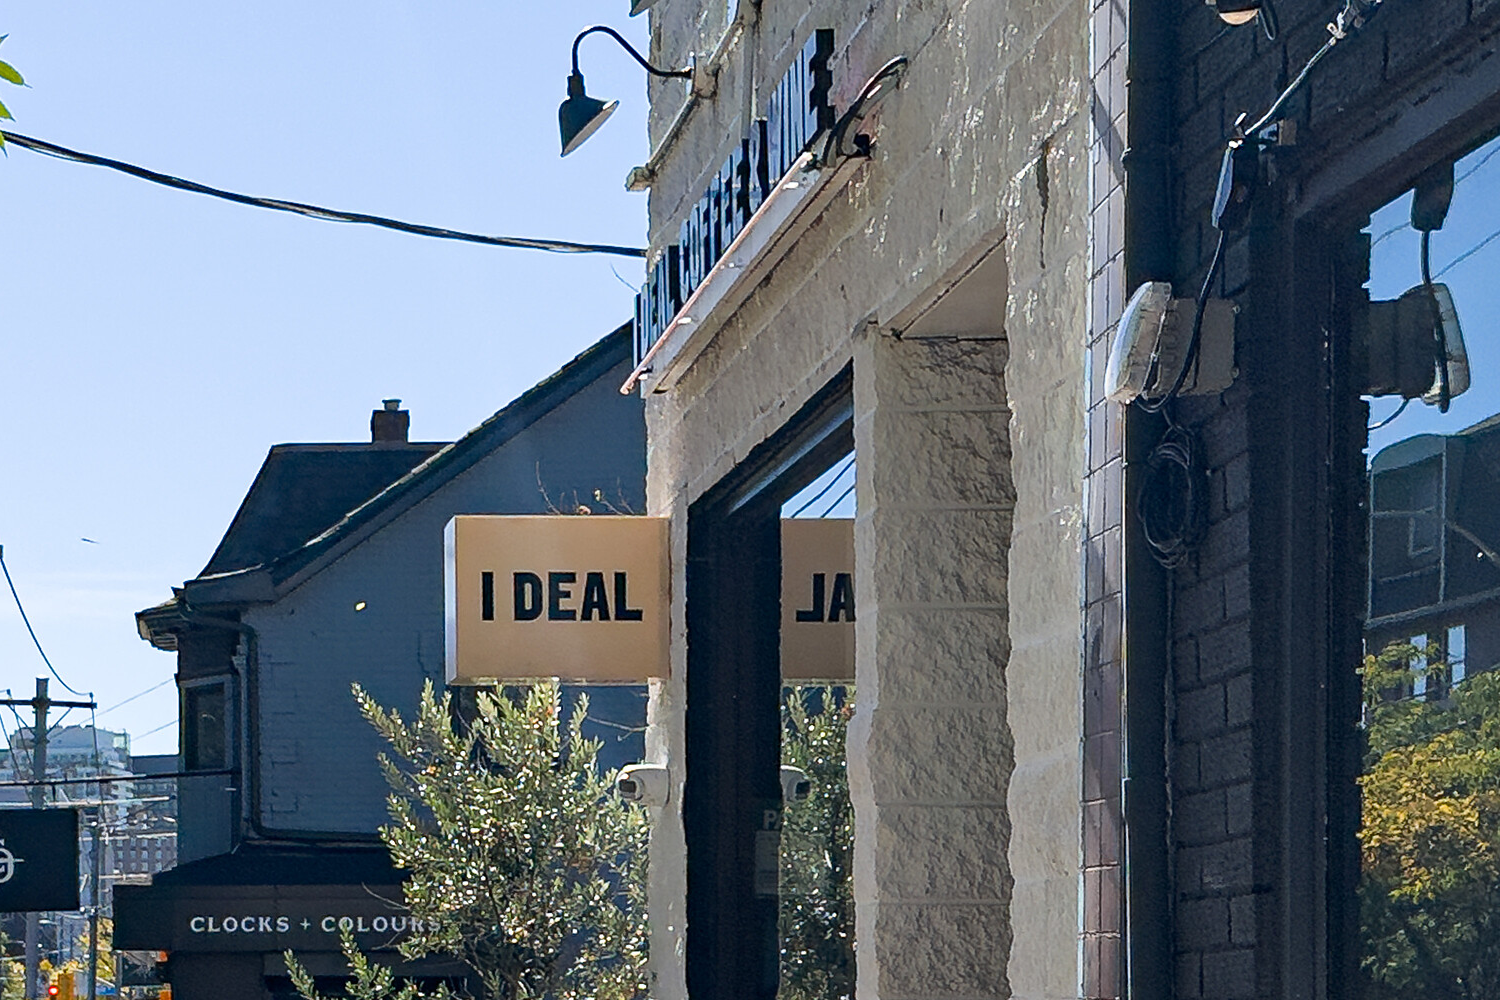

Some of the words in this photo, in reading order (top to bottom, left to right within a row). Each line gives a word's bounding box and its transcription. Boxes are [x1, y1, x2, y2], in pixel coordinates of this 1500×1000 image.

[679, 143, 746, 304] COFFEE
[767, 30, 826, 185] WINE
[481, 571, 494, 621] I
[513, 571, 643, 621] DEAL
[190, 916, 290, 933] CLOCKS
